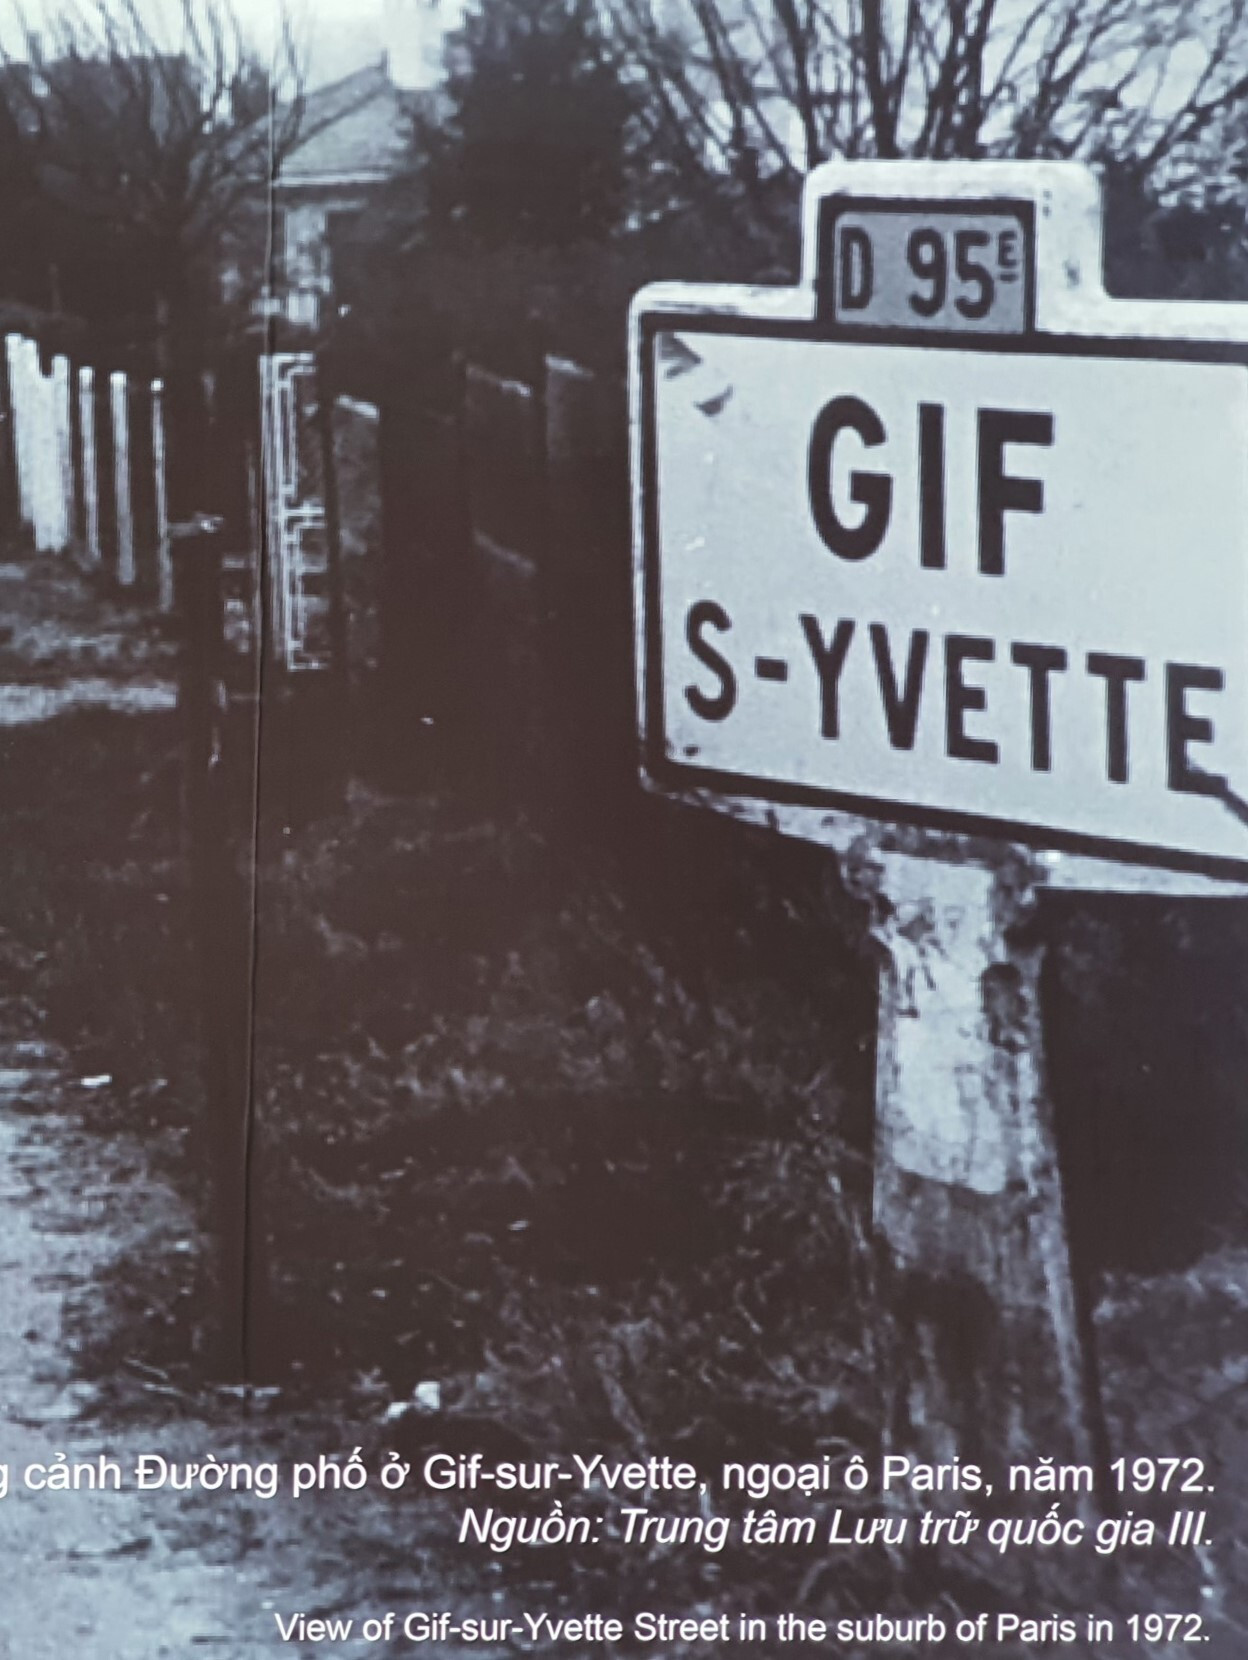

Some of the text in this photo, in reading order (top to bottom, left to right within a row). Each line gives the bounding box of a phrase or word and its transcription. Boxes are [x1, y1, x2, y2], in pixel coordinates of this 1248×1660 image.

[840, 225, 873, 310] D
[807, 394, 1056, 578] GIF
[683, 599, 1226, 795] S-YVETTE
